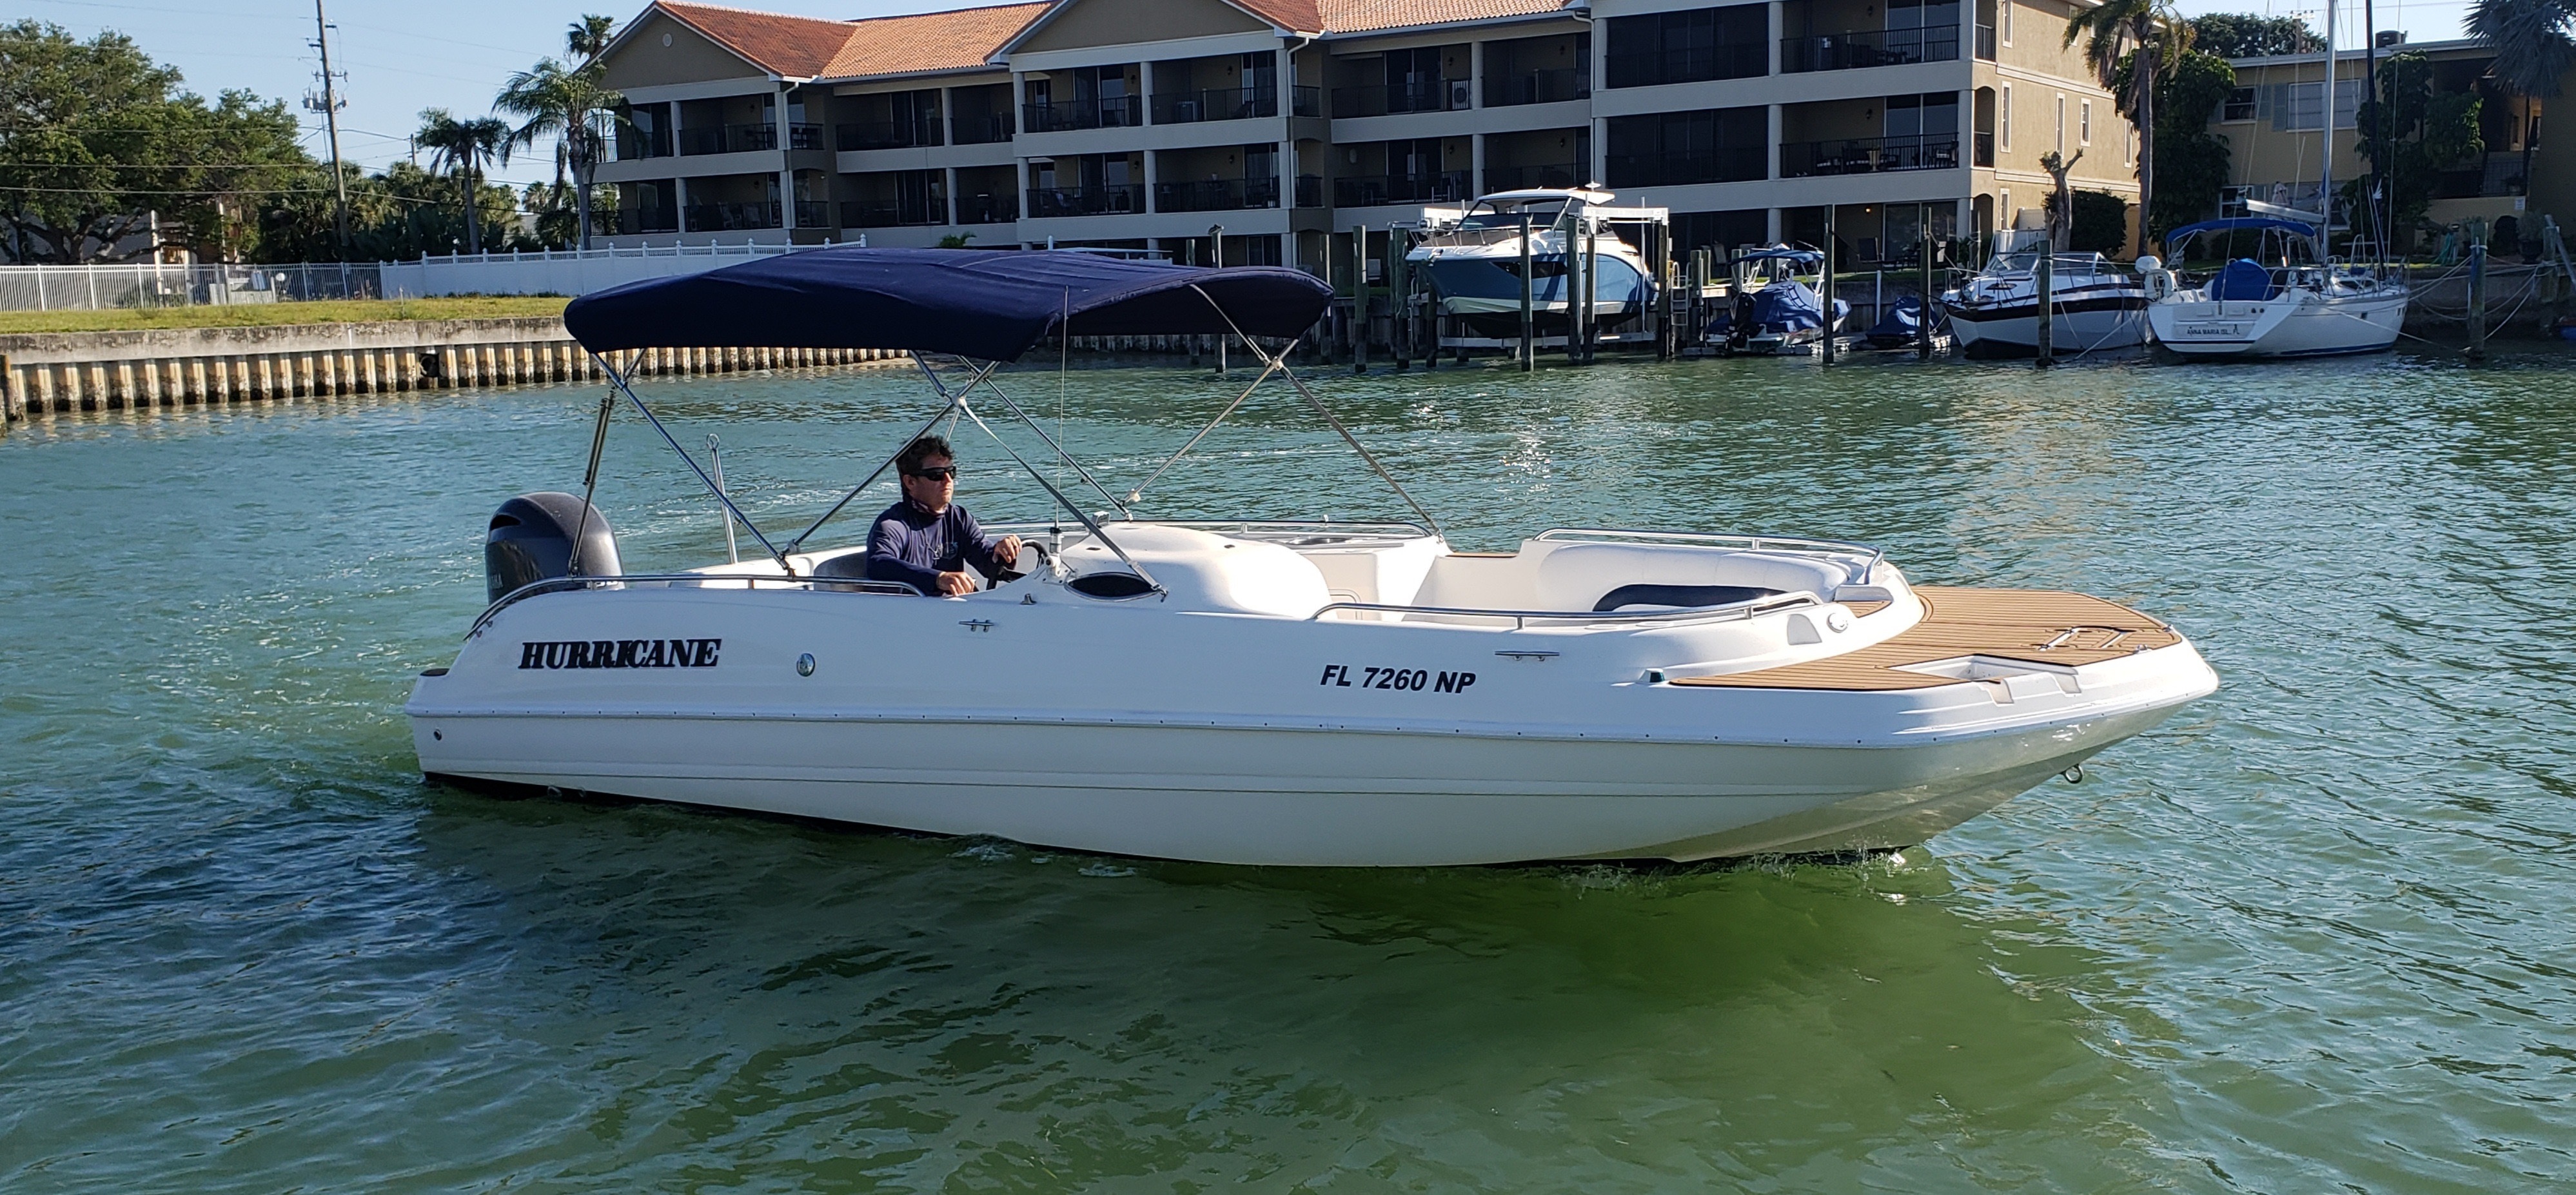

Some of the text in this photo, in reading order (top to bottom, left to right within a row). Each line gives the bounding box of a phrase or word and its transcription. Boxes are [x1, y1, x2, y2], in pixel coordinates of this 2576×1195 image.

[518, 638, 722, 669] HURRICANE
[1320, 665, 1476, 694] FL 7260 NP
